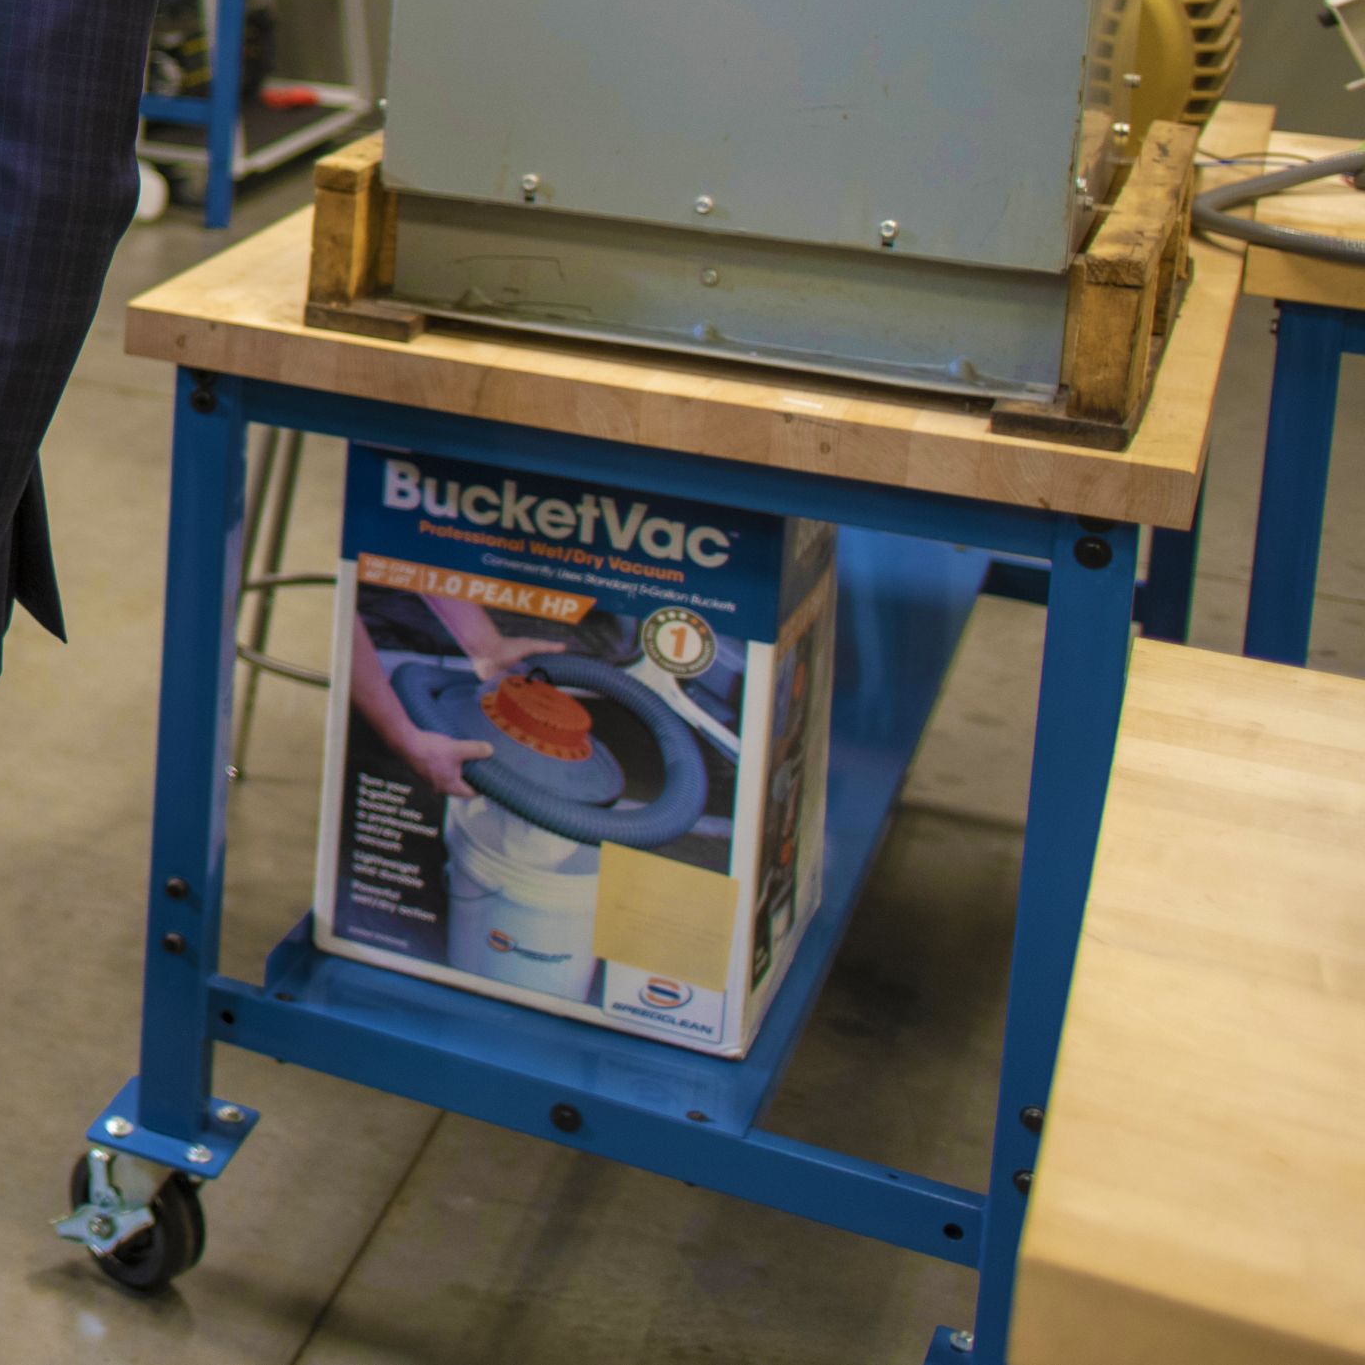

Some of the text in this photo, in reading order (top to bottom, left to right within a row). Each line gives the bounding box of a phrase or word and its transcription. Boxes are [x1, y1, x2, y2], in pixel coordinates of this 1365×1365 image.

[382, 458, 731, 569] BucketVac
[419, 520, 685, 582] Professional Wet/Dry Vacuum
[427, 572, 579, 618] 1.0 PEAK HP
[670, 626, 687, 658] 1
